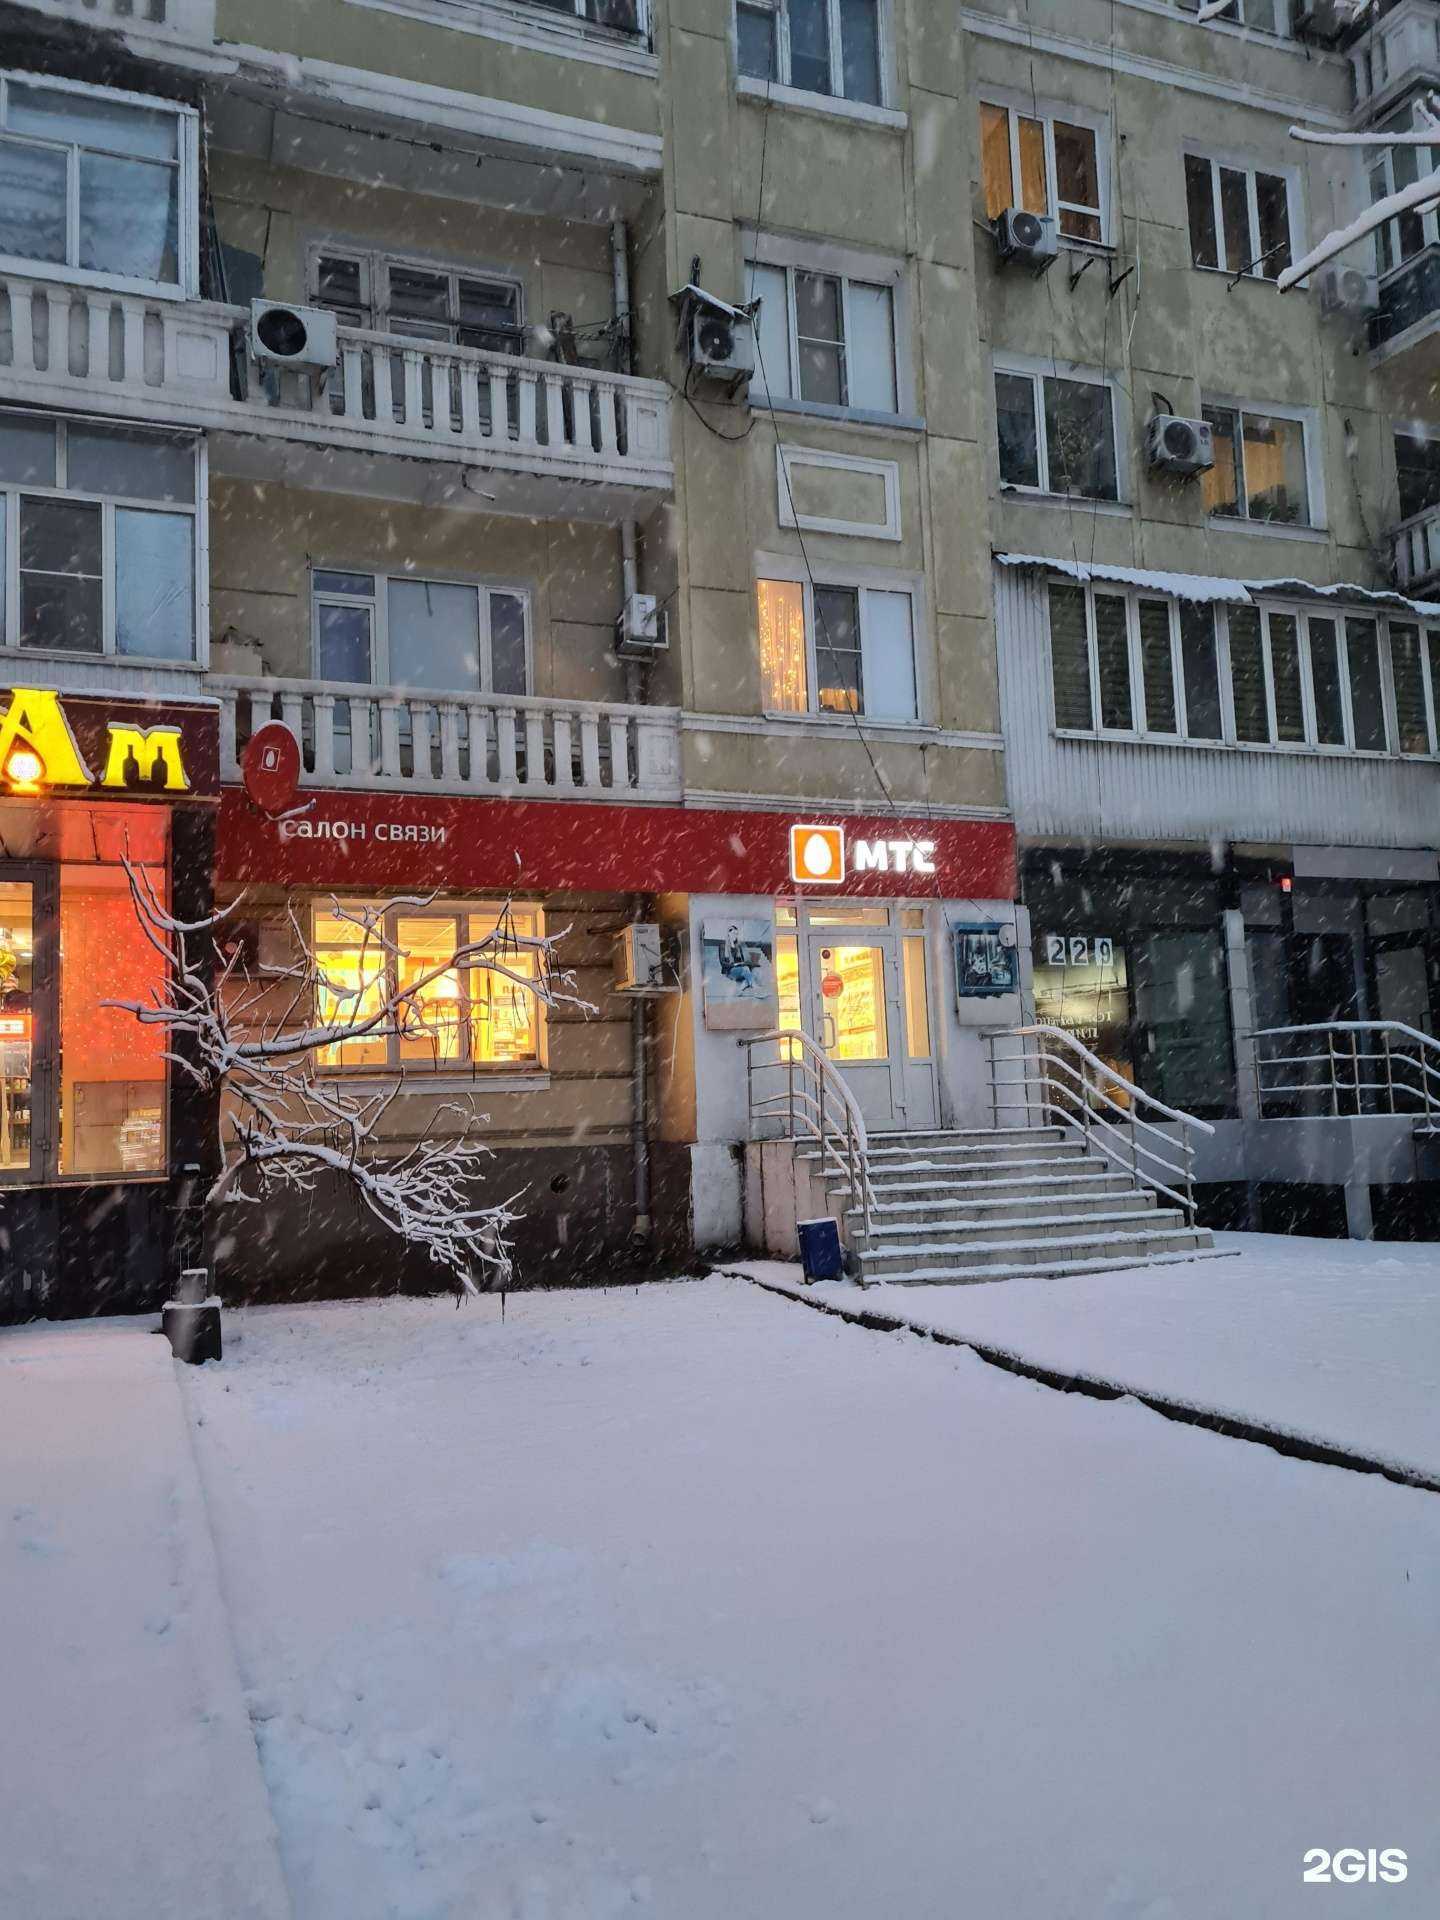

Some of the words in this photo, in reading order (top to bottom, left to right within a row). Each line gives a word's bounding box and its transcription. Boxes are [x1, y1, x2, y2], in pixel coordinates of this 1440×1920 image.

[282, 820, 366, 840] салон
[375, 824, 447, 843] связи
[855, 839, 936, 872] МТС
